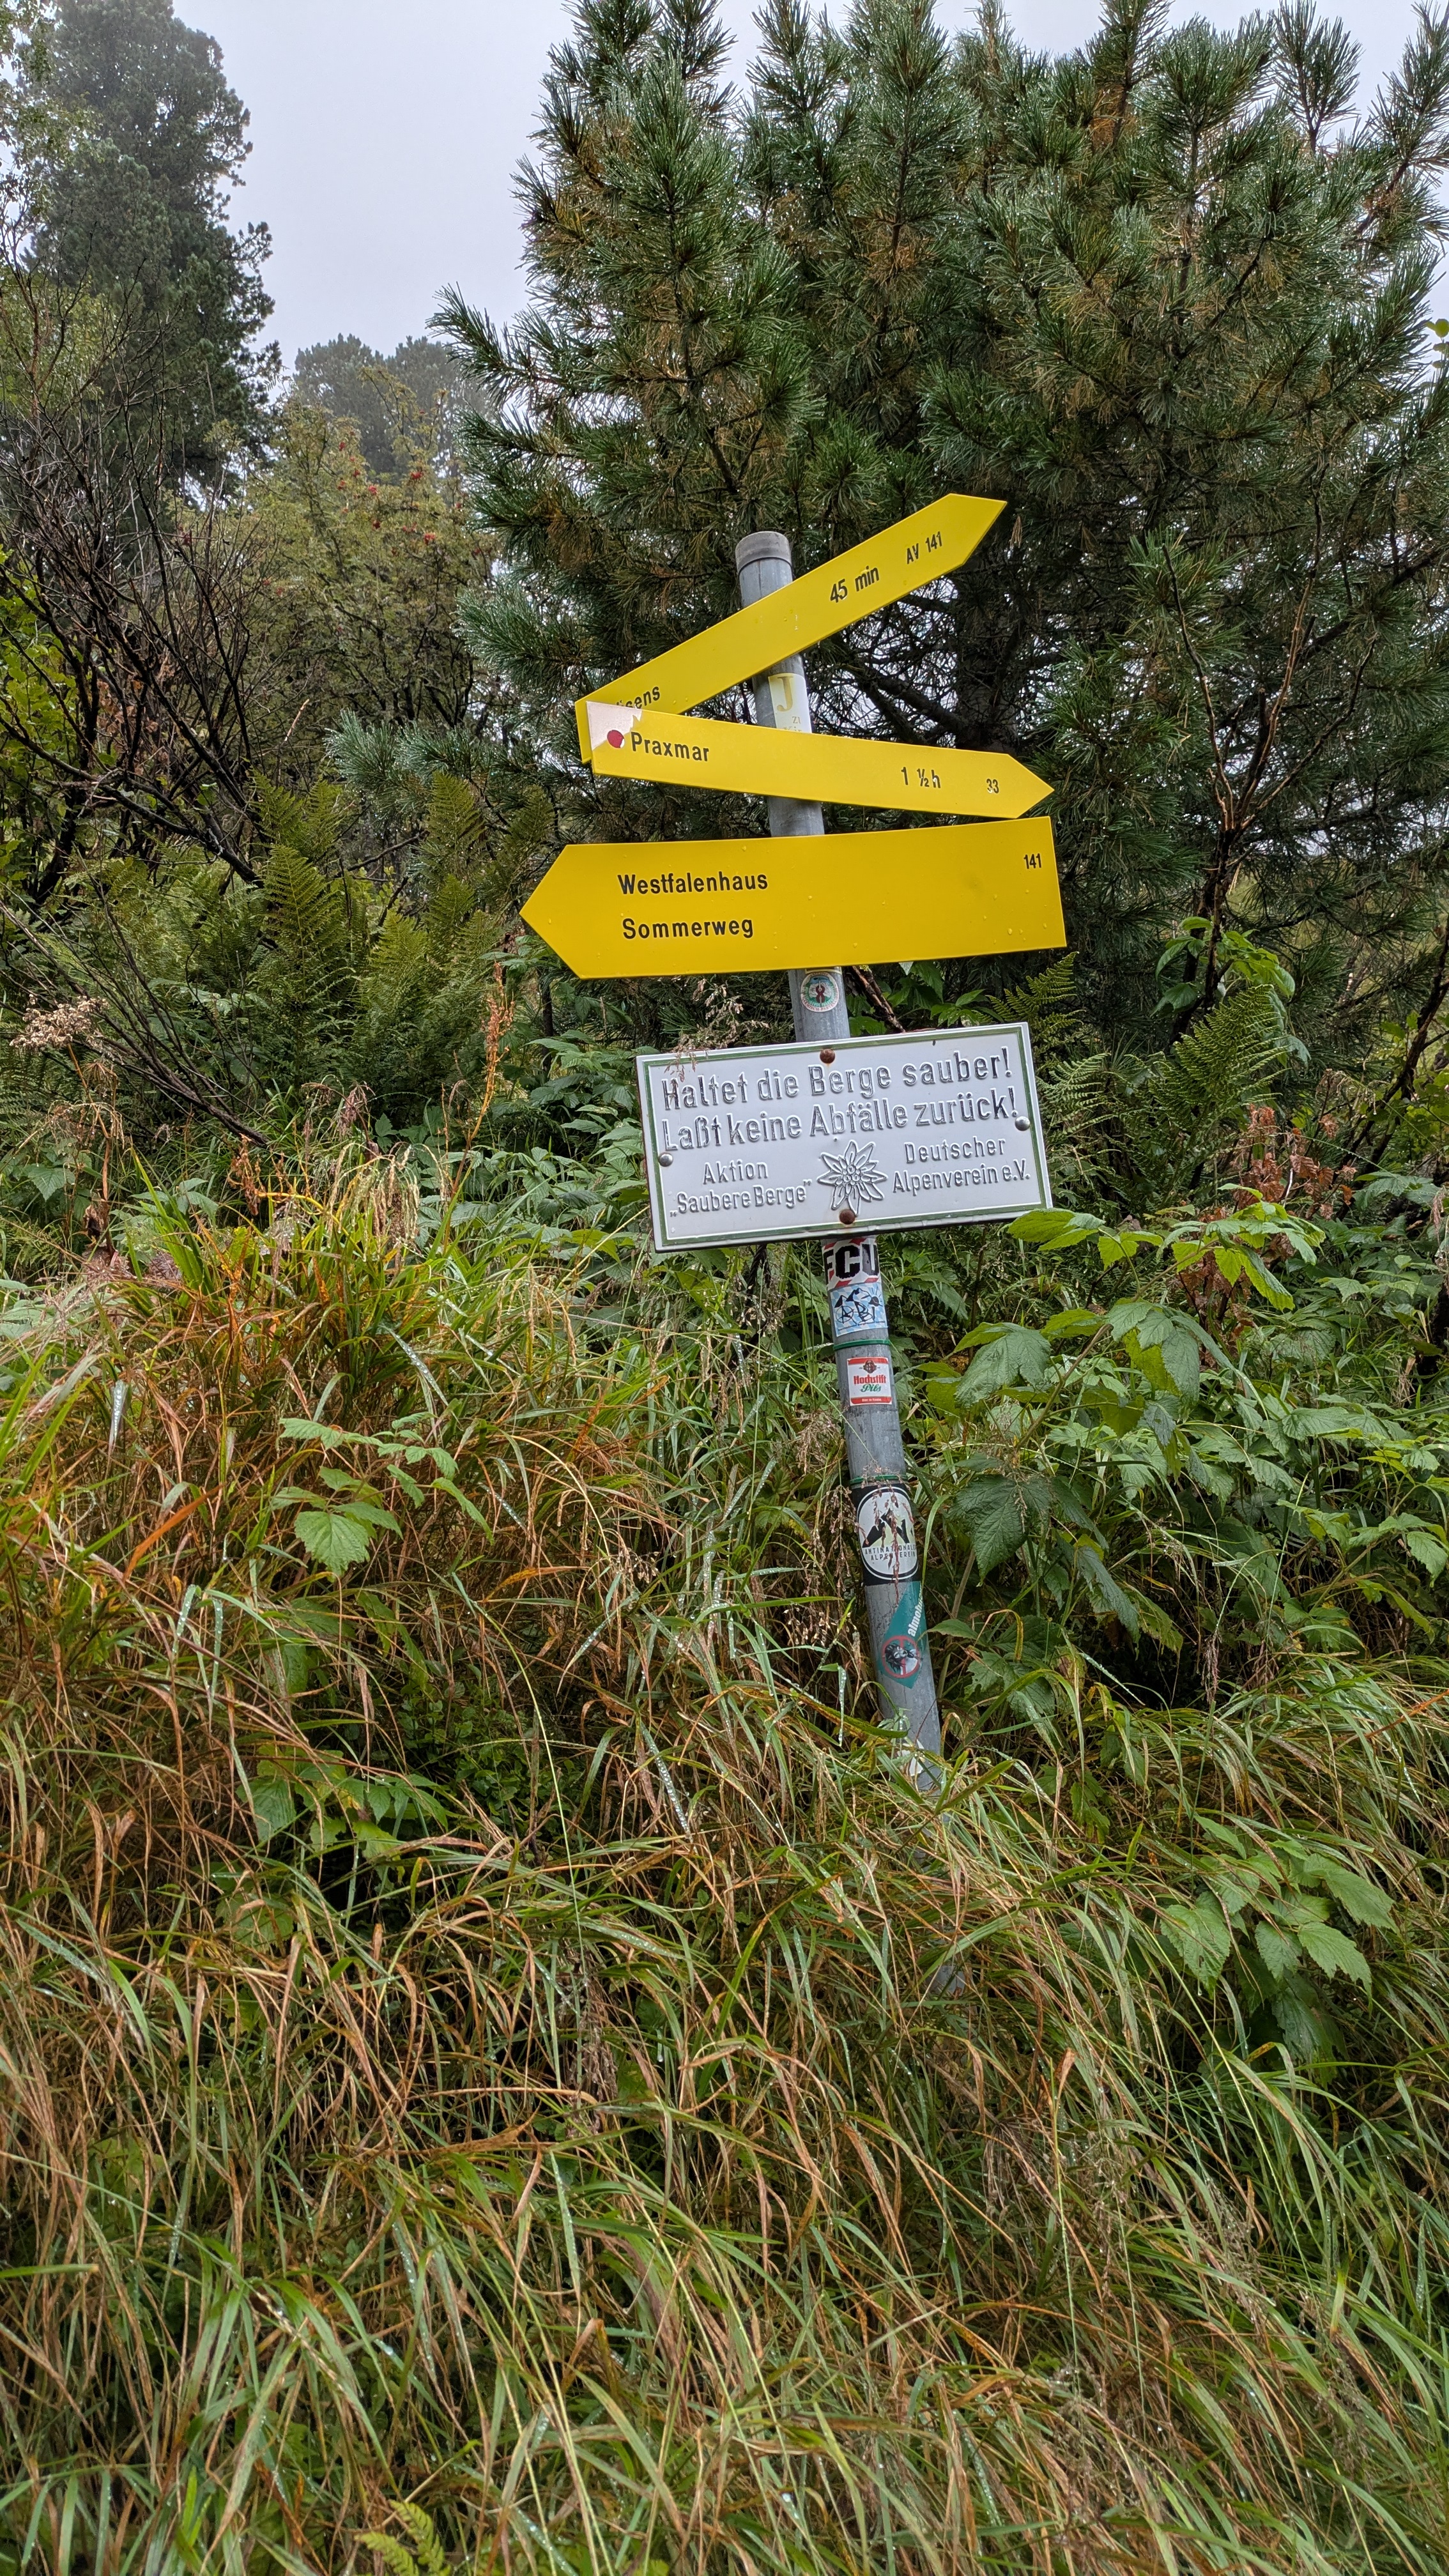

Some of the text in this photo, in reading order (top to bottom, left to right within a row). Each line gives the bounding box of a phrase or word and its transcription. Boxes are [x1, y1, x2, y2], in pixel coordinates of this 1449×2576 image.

[830, 578, 848, 603] 45
[855, 565, 880, 592] min
[907, 543, 919, 564] AV
[925, 531, 942, 553] 141
[630, 732, 709, 762] Praxmar
[901, 767, 908, 786] 1
[986, 778, 999, 794] 33
[1023, 853, 1042, 870] 141
[617, 871, 768, 894] Westfalenhaus
[622, 918, 753, 939] Sommerweg
[661, 1046, 1013, 1110] Haltet die Berge sauber!
[661, 1086, 1018, 1151] Laßt keine Abfälle zurück!
[904, 1135, 1006, 1164] Deutscher
[703, 1159, 769, 1184] Aktion
[893, 1158, 1031, 1197] Alpenverein e.V.
[854, 1374, 886, 1385] Hochstift
[860, 1384, 881, 1392] Pils
